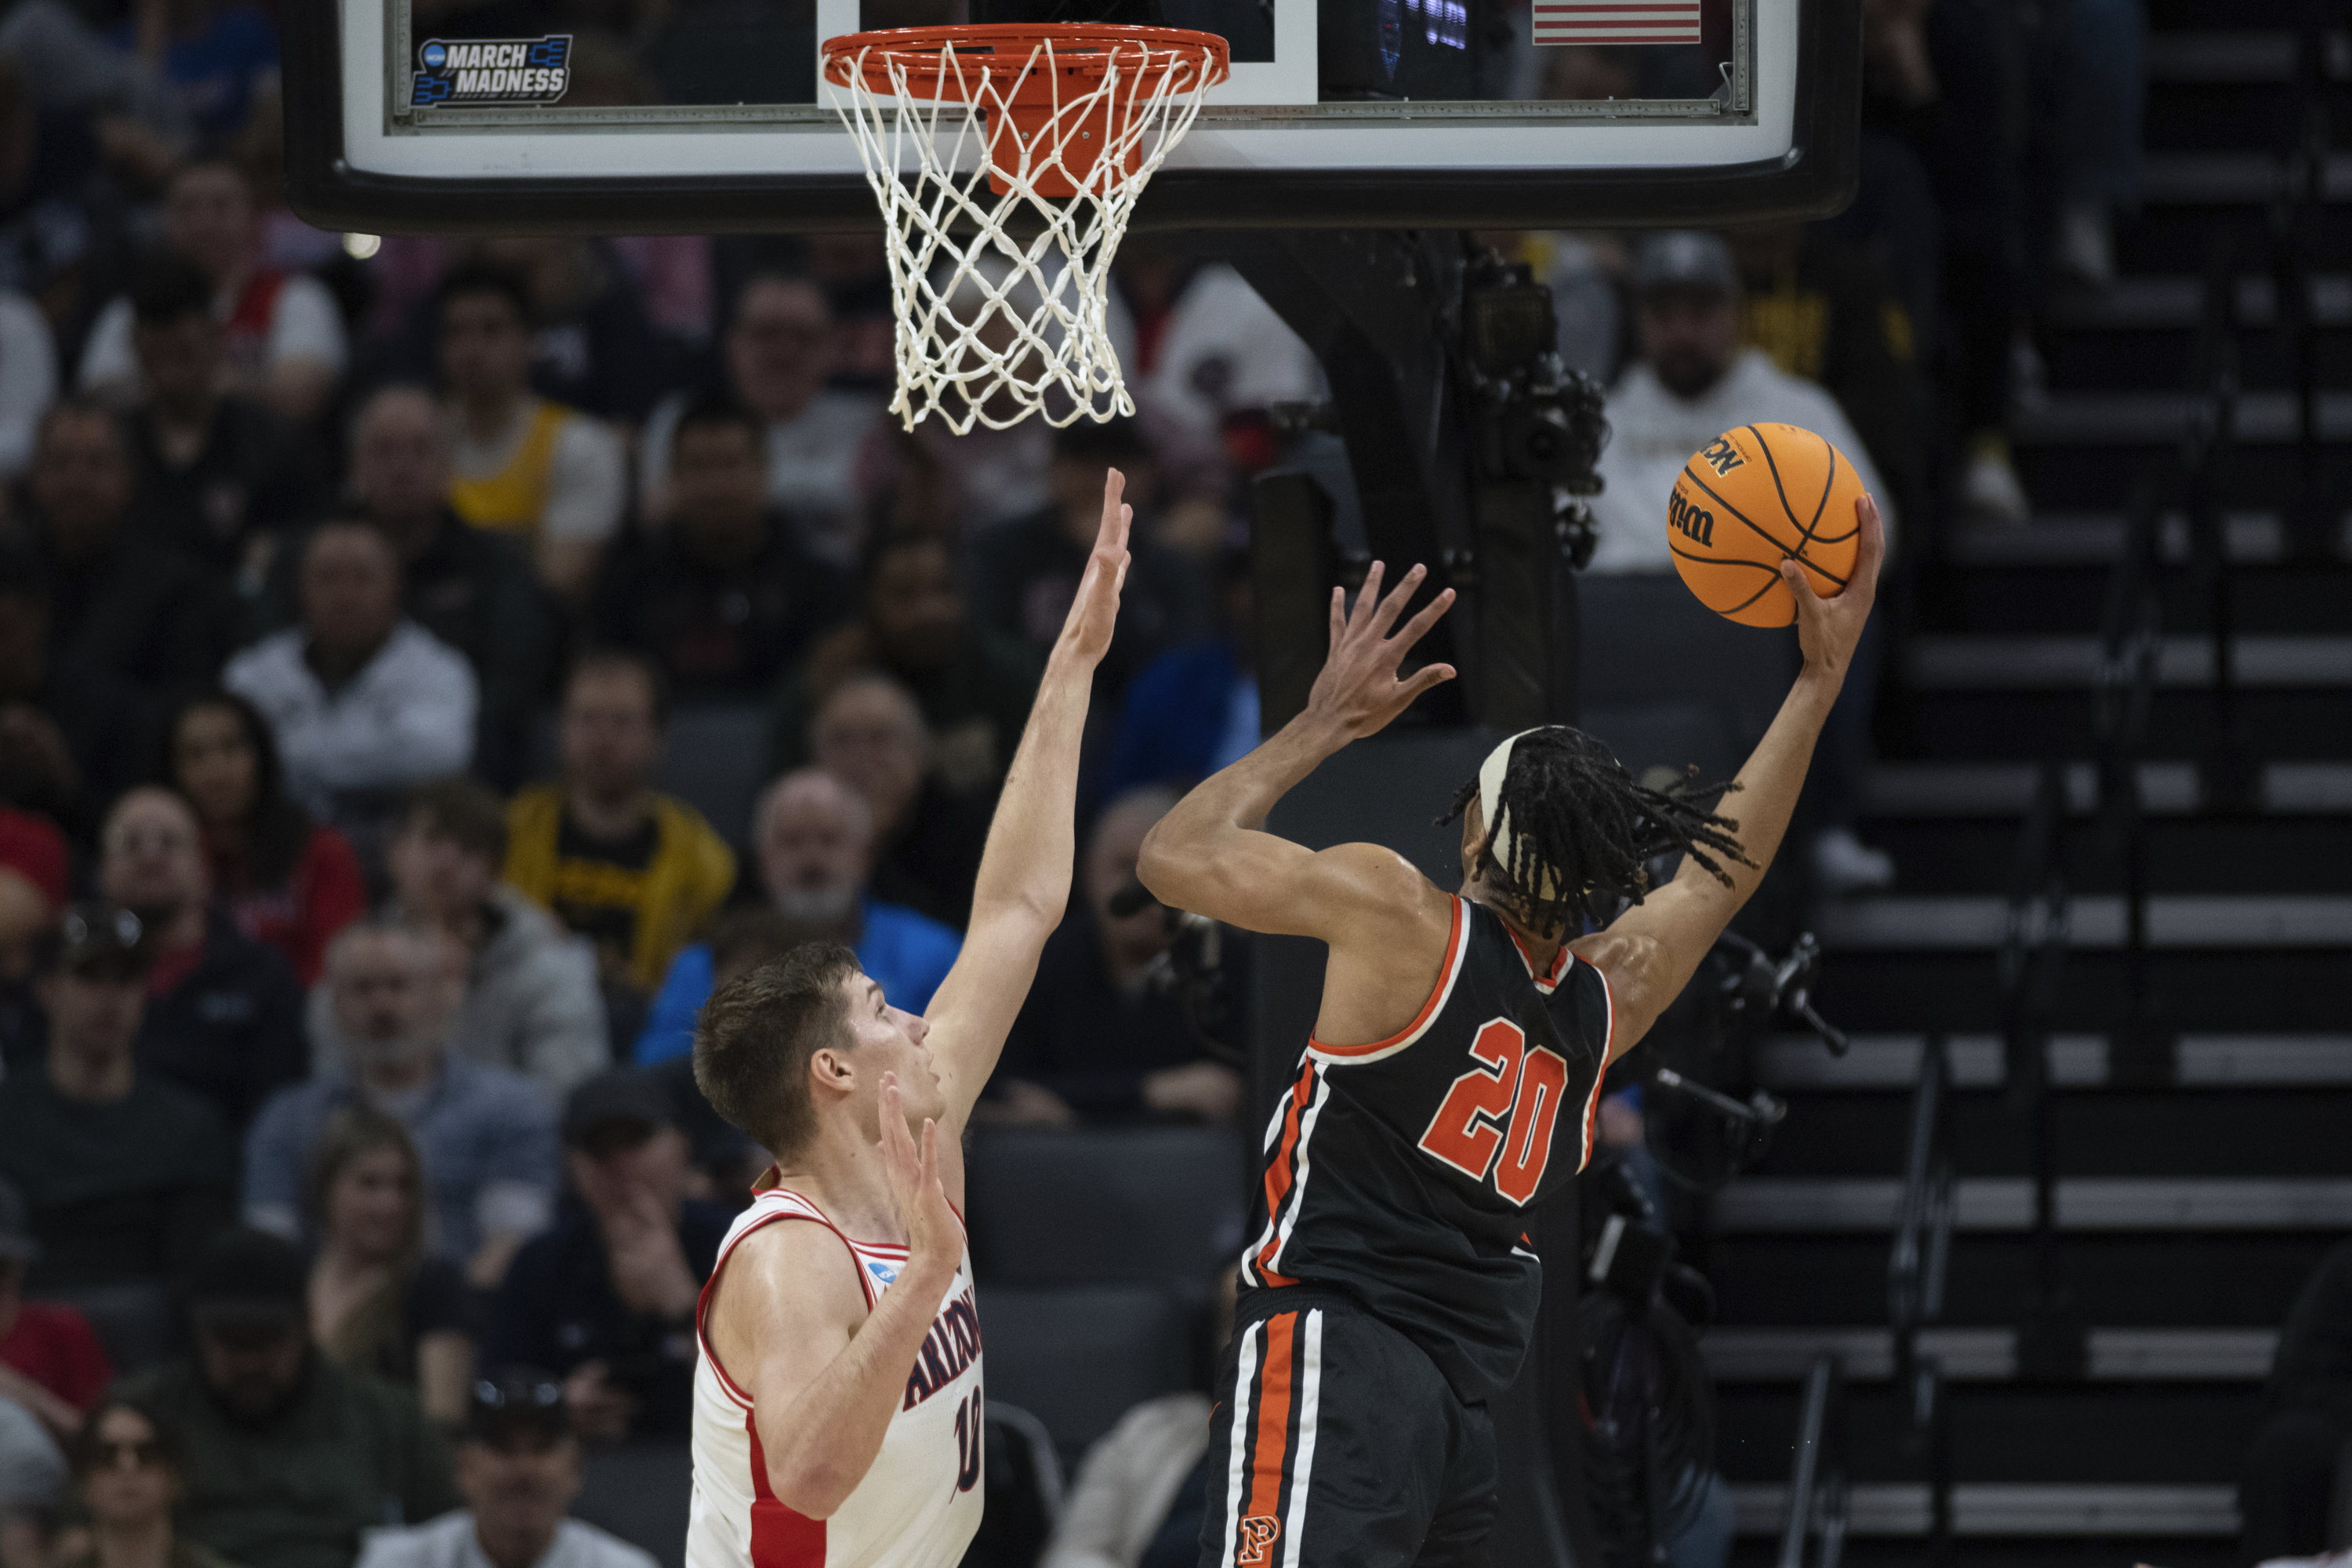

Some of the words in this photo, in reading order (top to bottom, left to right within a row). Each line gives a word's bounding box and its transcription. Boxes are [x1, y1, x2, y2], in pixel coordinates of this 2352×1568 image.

[447, 45, 528, 68] MARCH
[456, 68, 565, 93] MADNESS
[1417, 1016, 1568, 1207] 20
[949, 1385, 982, 1504] 10
[1240, 1515, 1279, 1563] P
